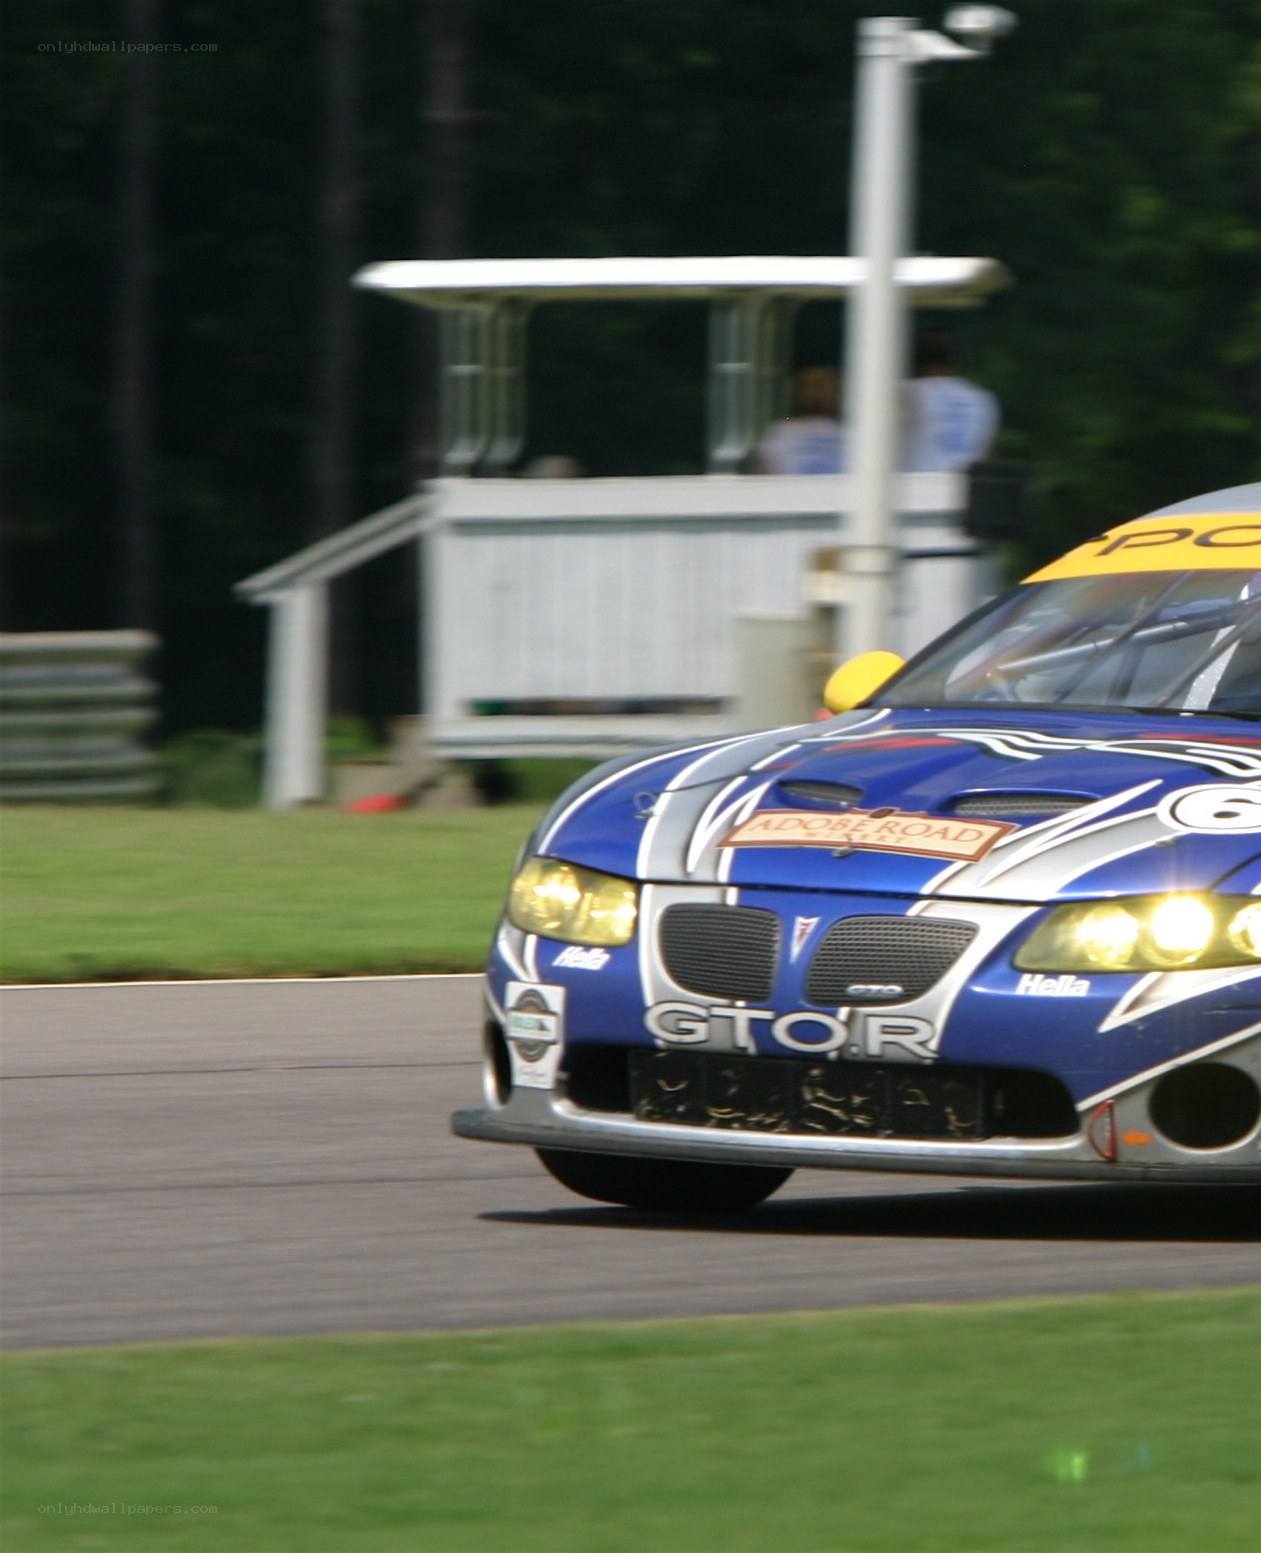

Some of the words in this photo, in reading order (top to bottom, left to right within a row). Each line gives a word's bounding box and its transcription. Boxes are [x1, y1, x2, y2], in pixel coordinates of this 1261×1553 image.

[749, 817, 868, 833] ADOBE
[874, 819, 984, 843] ROAD
[847, 984, 904, 998] GTO
[1016, 973, 1091, 997] Hella
